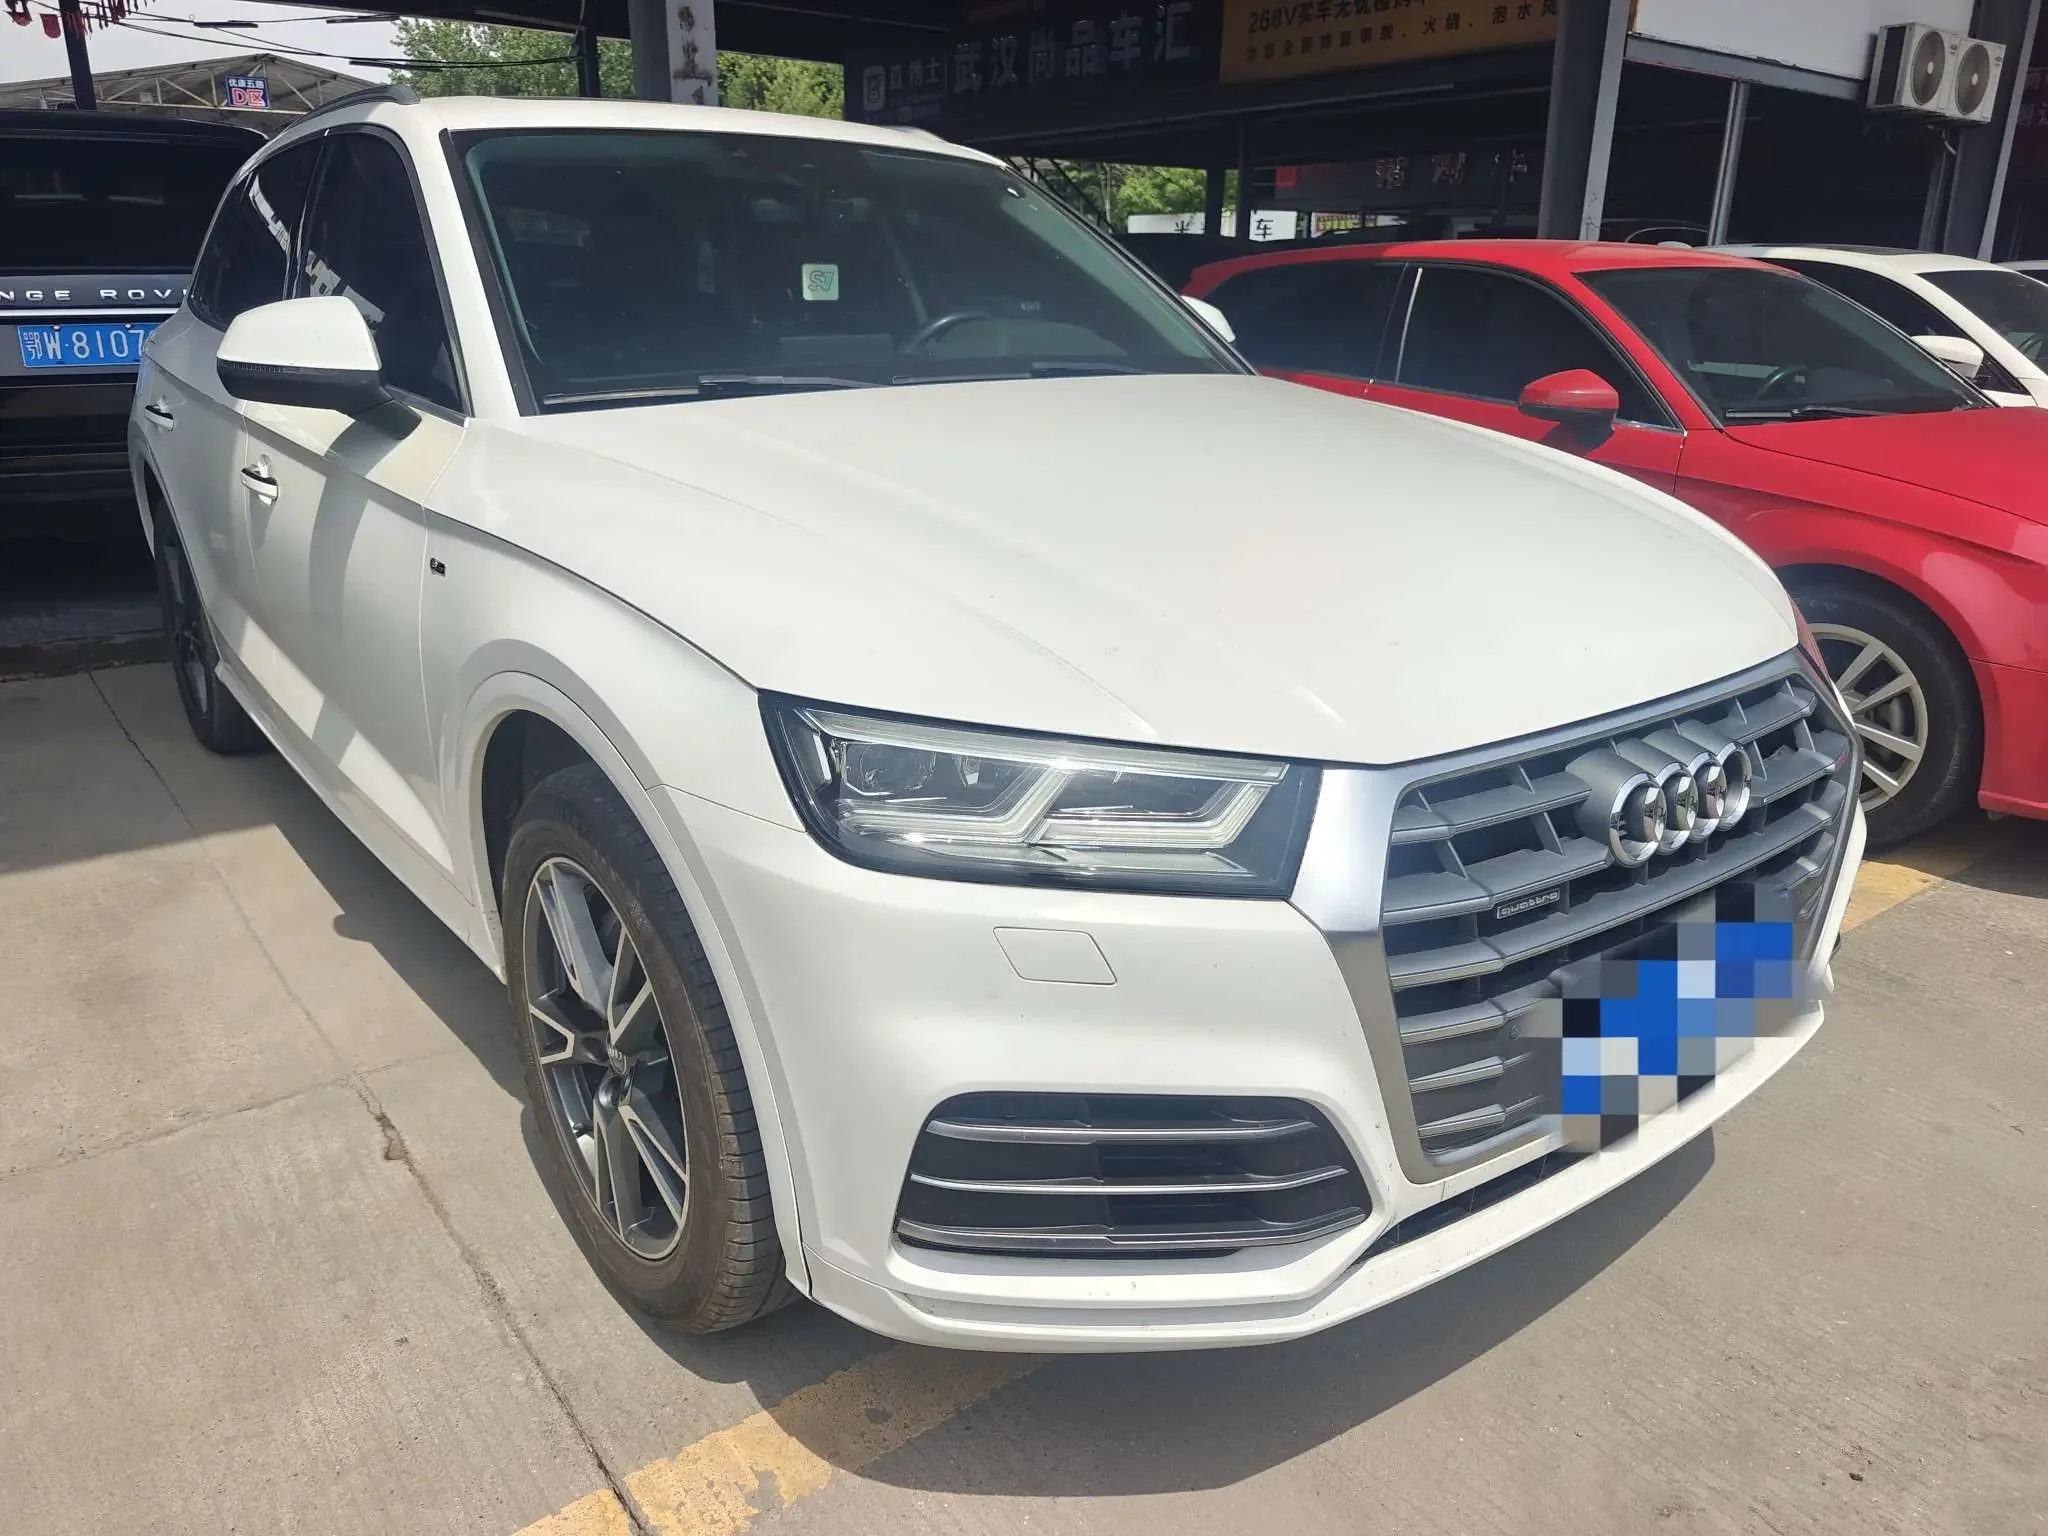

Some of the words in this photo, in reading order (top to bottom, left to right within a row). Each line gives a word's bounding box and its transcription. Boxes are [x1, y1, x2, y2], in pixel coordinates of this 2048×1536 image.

[953, 1, 1195, 93] 武汉尚品车汇
[99, 289, 187, 302] ROV
[1499, 889, 1559, 917] quattro
